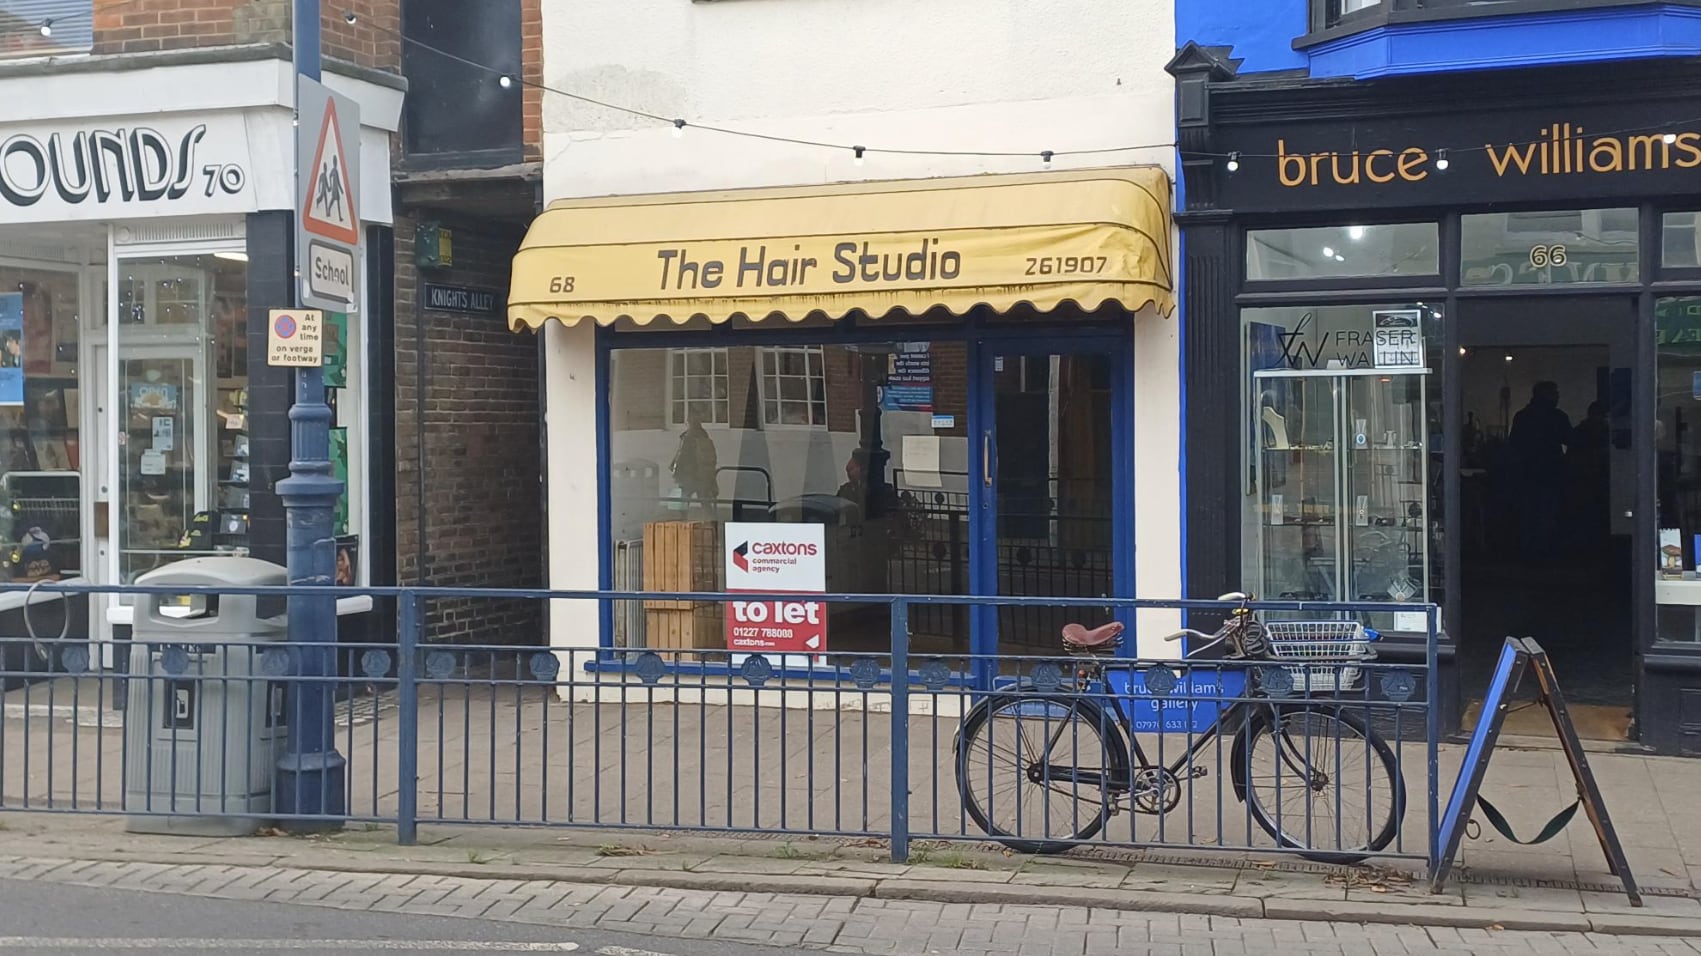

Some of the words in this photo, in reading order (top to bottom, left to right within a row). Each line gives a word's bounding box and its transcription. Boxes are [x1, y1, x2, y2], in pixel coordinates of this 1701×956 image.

[1278, 139, 1428, 186] bruce
[1485, 122, 1701, 177] williams
[203, 163, 245, 197] 70
[657, 249, 724, 289] The
[736, 244, 817, 288] Hair
[832, 238, 961, 284] Studio
[1530, 245, 1567, 267] 66
[315, 256, 349, 286] School
[1025, 256, 1107, 276] 261907
[550, 277, 575, 293] 68
[431, 288, 467, 309] KNIGHTS
[470, 291, 495, 311] ALLEY
[302, 324, 317, 332] any
[300, 333, 319, 341] time
[1335, 329, 1416, 347] FRASER
[283, 353, 318, 363] footway
[290, 345, 314, 354] verge
[752, 541, 817, 556] caxtons
[752, 558, 797, 566] commercial
[752, 566, 780, 574] agency
[733, 601, 767, 622] to
[775, 600, 820, 625] let
[733, 627, 759, 637] 01227
